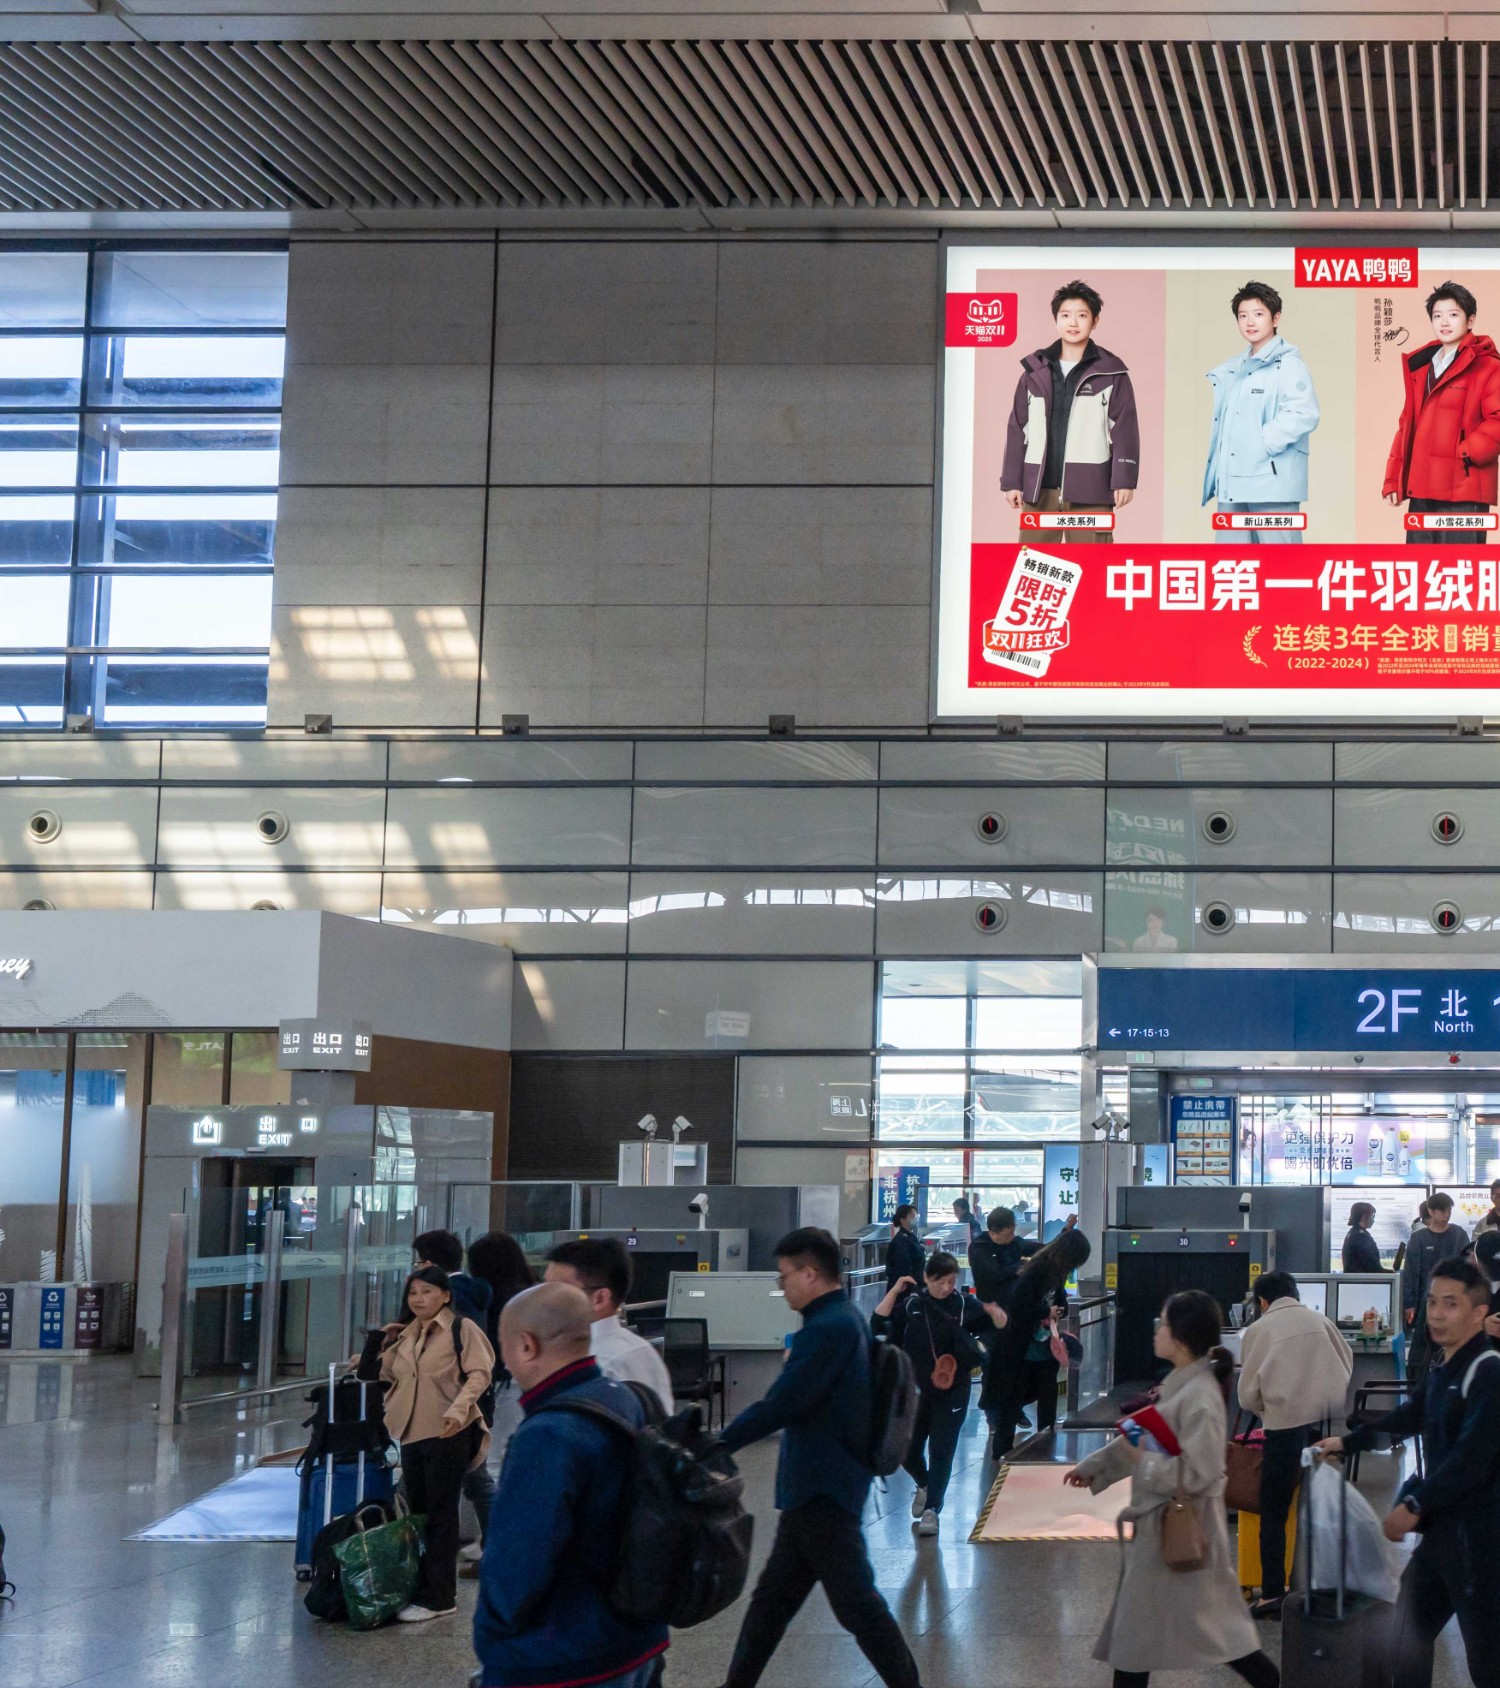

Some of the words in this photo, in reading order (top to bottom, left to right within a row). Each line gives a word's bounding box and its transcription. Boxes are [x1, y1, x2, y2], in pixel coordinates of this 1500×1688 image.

[1302, 258, 1411, 282] YAYA鸭鸭
[1384, 298, 1393, 326] 孙颖莎
[965, 325, 1005, 336] 天猫双11
[1057, 516, 1096, 527] 冰壳系列
[1244, 516, 1293, 527] 新山系系列
[1435, 516, 1484, 527] 小雪花系列
[1023, 558, 1075, 584] 畅销新款
[1014, 575, 1068, 608] 限时
[1004, 599, 1059, 630] 5折
[987, 630, 1065, 650] 双11狂欢
[1440, 989, 1469, 1017] 北
[1357, 989, 1421, 1033] 2F
[1435, 1021, 1474, 1033] North
[283, 1033, 300, 1045] 出口
[313, 1032, 342, 1045] 出口
[355, 1034, 369, 1047] 出口
[1183, 1100, 1225, 1110] 禁止携带
[258, 1133, 292, 1145] EXIT
[1285, 1131, 1354, 1144] 更强保护力
[883, 1175, 898, 1222] 非杭州
[627, 1237, 637, 1246] 29
[1179, 1238, 1188, 1246] 30
